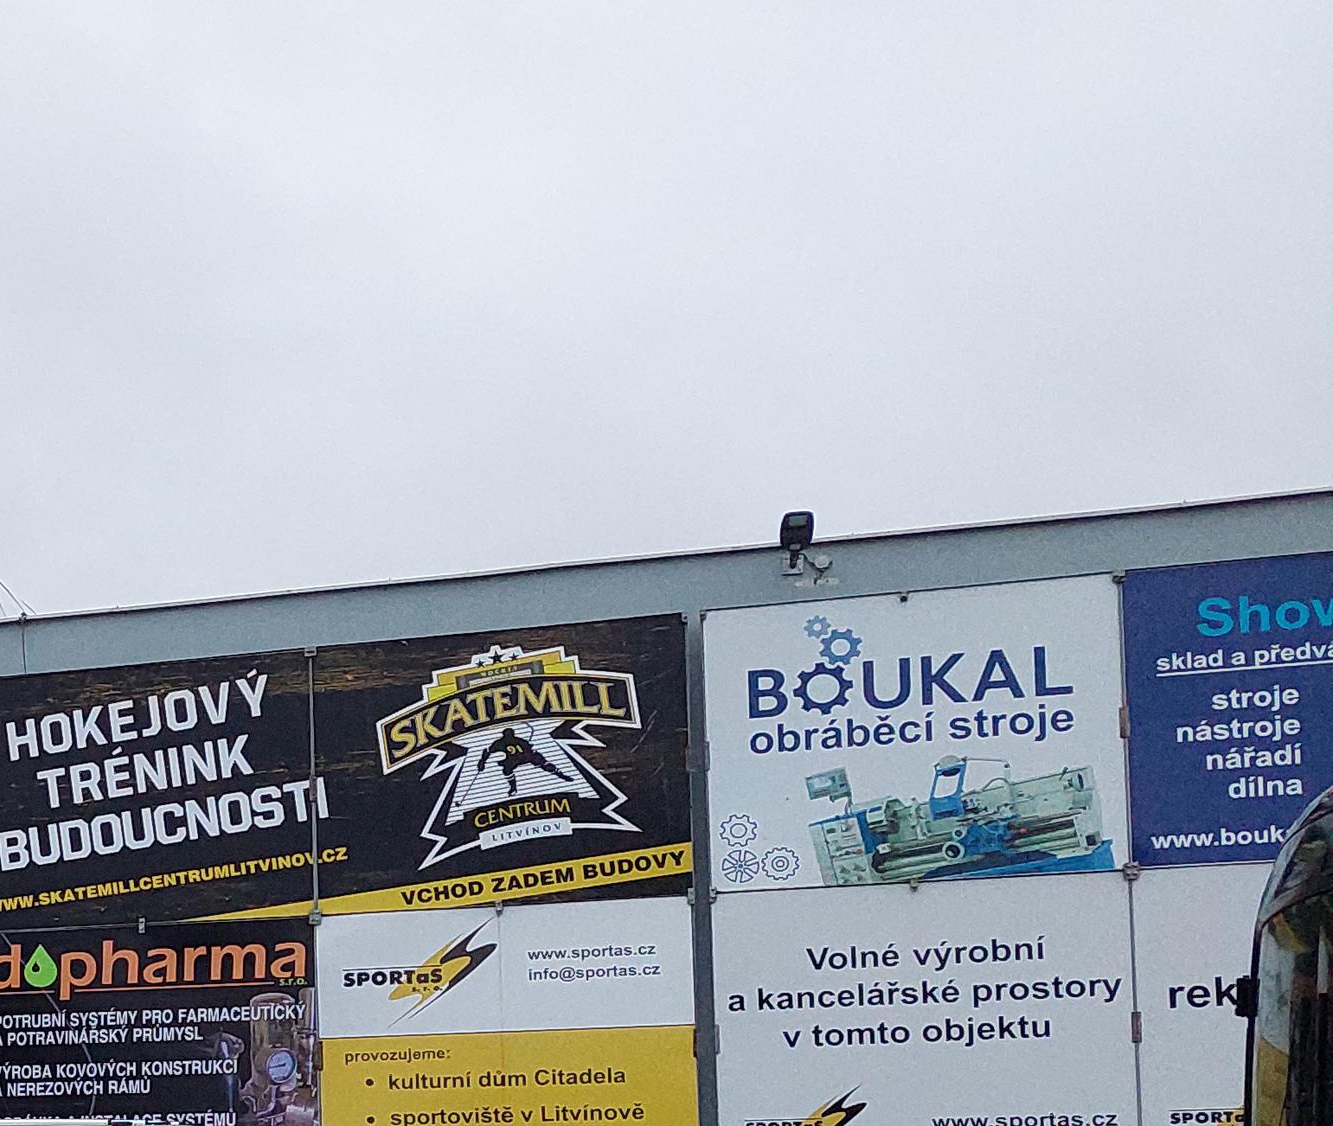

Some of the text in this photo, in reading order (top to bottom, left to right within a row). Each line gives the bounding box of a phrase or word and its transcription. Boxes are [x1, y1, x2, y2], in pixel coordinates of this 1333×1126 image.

[1157, 649, 1224, 671] sklad
[1231, 651, 1246, 666] a
[747, 645, 1074, 719] BOUKAL
[1212, 685, 1300, 712] stroje
[6, 668, 268, 762] HOKEJOVÝ
[389, 679, 626, 759] SKATEMILL
[750, 703, 1074, 754] obráběcí stroje
[1176, 715, 1301, 743] nástroje
[1206, 743, 1302, 770] nářadí
[37, 734, 254, 808] TRÉNINK
[1228, 776, 1303, 799] dílna
[474, 798, 571, 829] CENTRUM
[491, 821, 563, 842] LITVÍNOV
[1150, 825, 1287, 849] www.bouk
[400, 850, 686, 906] VCHOD ZADEM BUDOVY
[528, 943, 656, 962] www.sportas.cz
[806, 935, 1045, 971] Volné výrobní
[278, 977, 308, 987] s.r.o.
[528, 963, 660, 982] info@sportas.cz
[728, 976, 1122, 1012] a kancelářské prostory
[70, 1010, 136, 1028] SYSTÉMY
[142, 1009, 174, 1025] PRO
[178, 1003, 306, 1023] FARMACEUTICKÝ
[7, 1026, 129, 1046] POTRAVINÁŘSKÝ
[133, 1024, 204, 1042] PRŮMYSL
[783, 1016, 1051, 1048] v tomto objektu
[56, 1060, 136, 1078] KOVOVÝCH
[141, 1058, 238, 1076] KONSTRUKCÍ
[344, 1047, 451, 1066] provozujeme:
[7, 1078, 106, 1096] NEREZOVÝCH
[110, 1075, 151, 1095] RÁMŮ
[388, 1067, 626, 1091] kulturní dům Citadela
[520, 1110, 533, 1122] v
[540, 1102, 645, 1123] Litvínově
